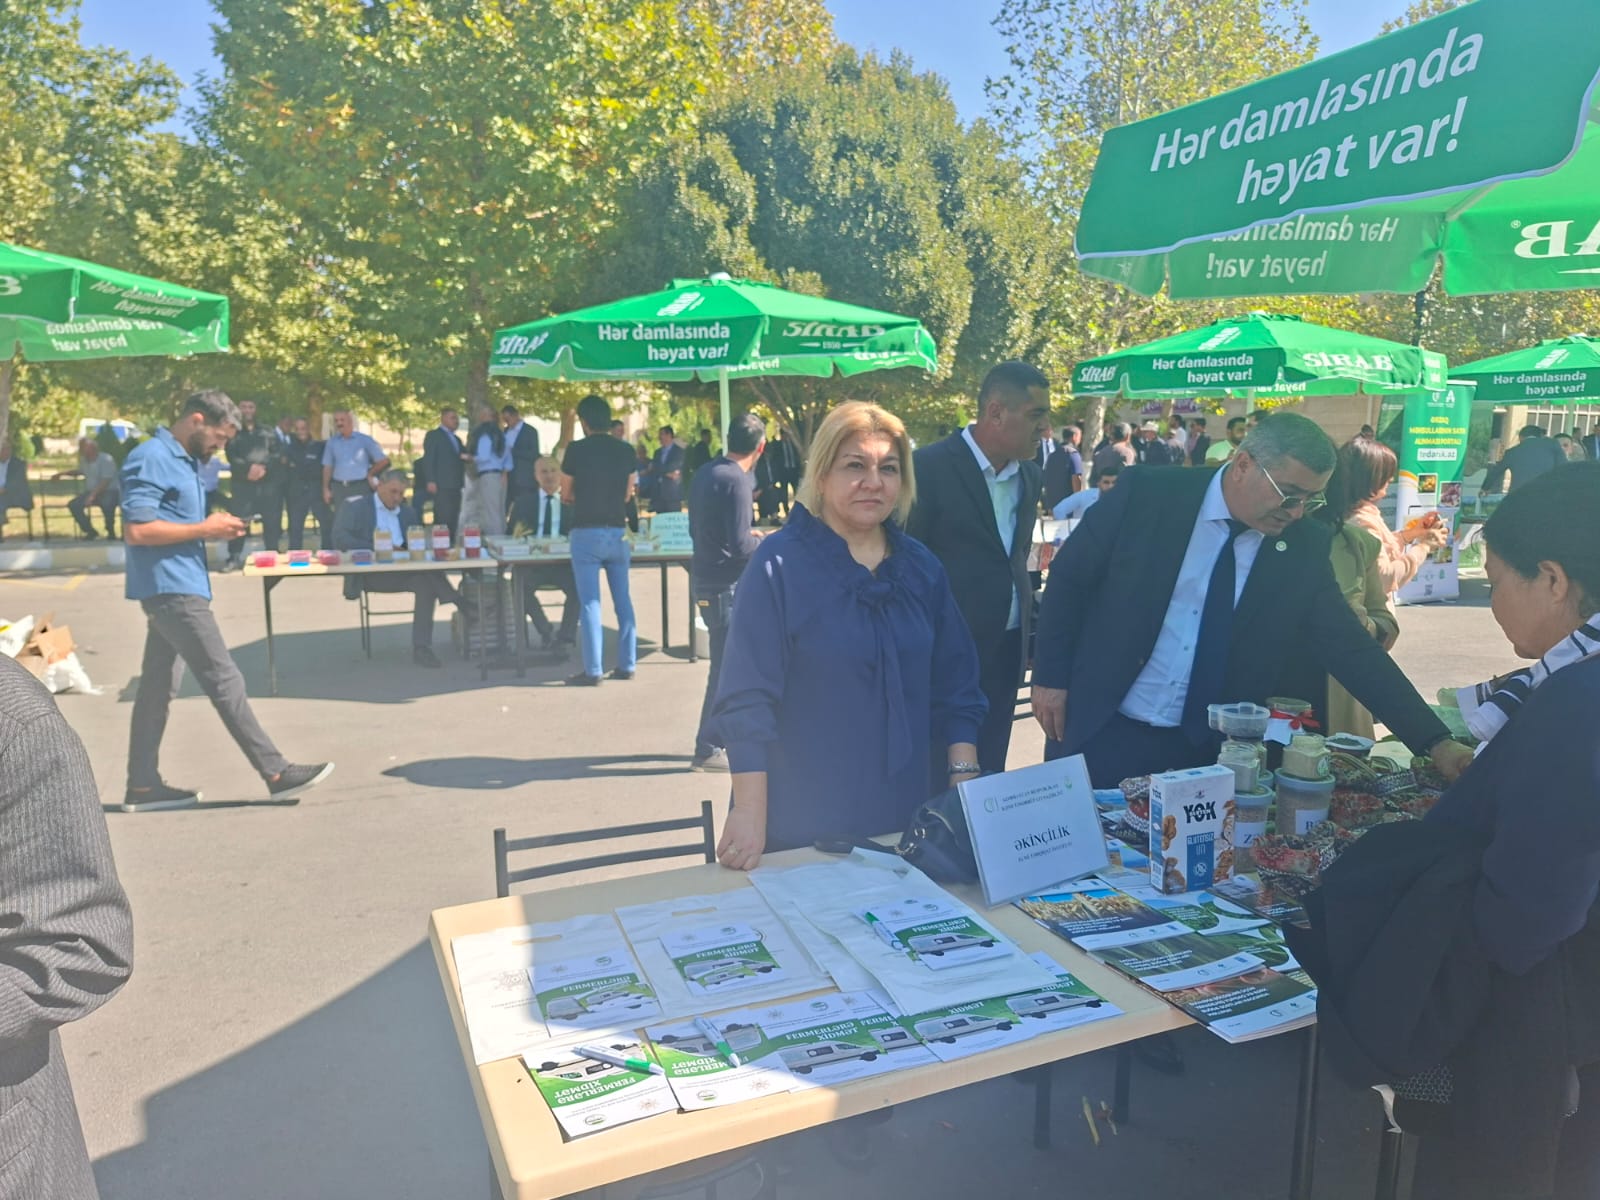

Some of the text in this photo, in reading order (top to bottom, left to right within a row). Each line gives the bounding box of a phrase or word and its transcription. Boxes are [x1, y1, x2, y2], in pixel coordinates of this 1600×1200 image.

[1150, 26, 1484, 172] Hər damlasında
[1236, 96, 1468, 205] həyat var!
[598, 321, 730, 341] Hər damlasında
[647, 343, 729, 364] həyat var!
[1152, 353, 1254, 370] Hər damlasında
[1302, 352, 1394, 371] SİRAB
[1078, 365, 1117, 383] SİRAB
[1187, 369, 1252, 386] həyat var!
[1493, 371, 1587, 385] Hər damlasında
[1525, 382, 1585, 396] həyat var!
[1014, 825, 1071, 851] ƏKİNÇİLİK
[557, 1077, 637, 1104] FERMERLƏRƏ
